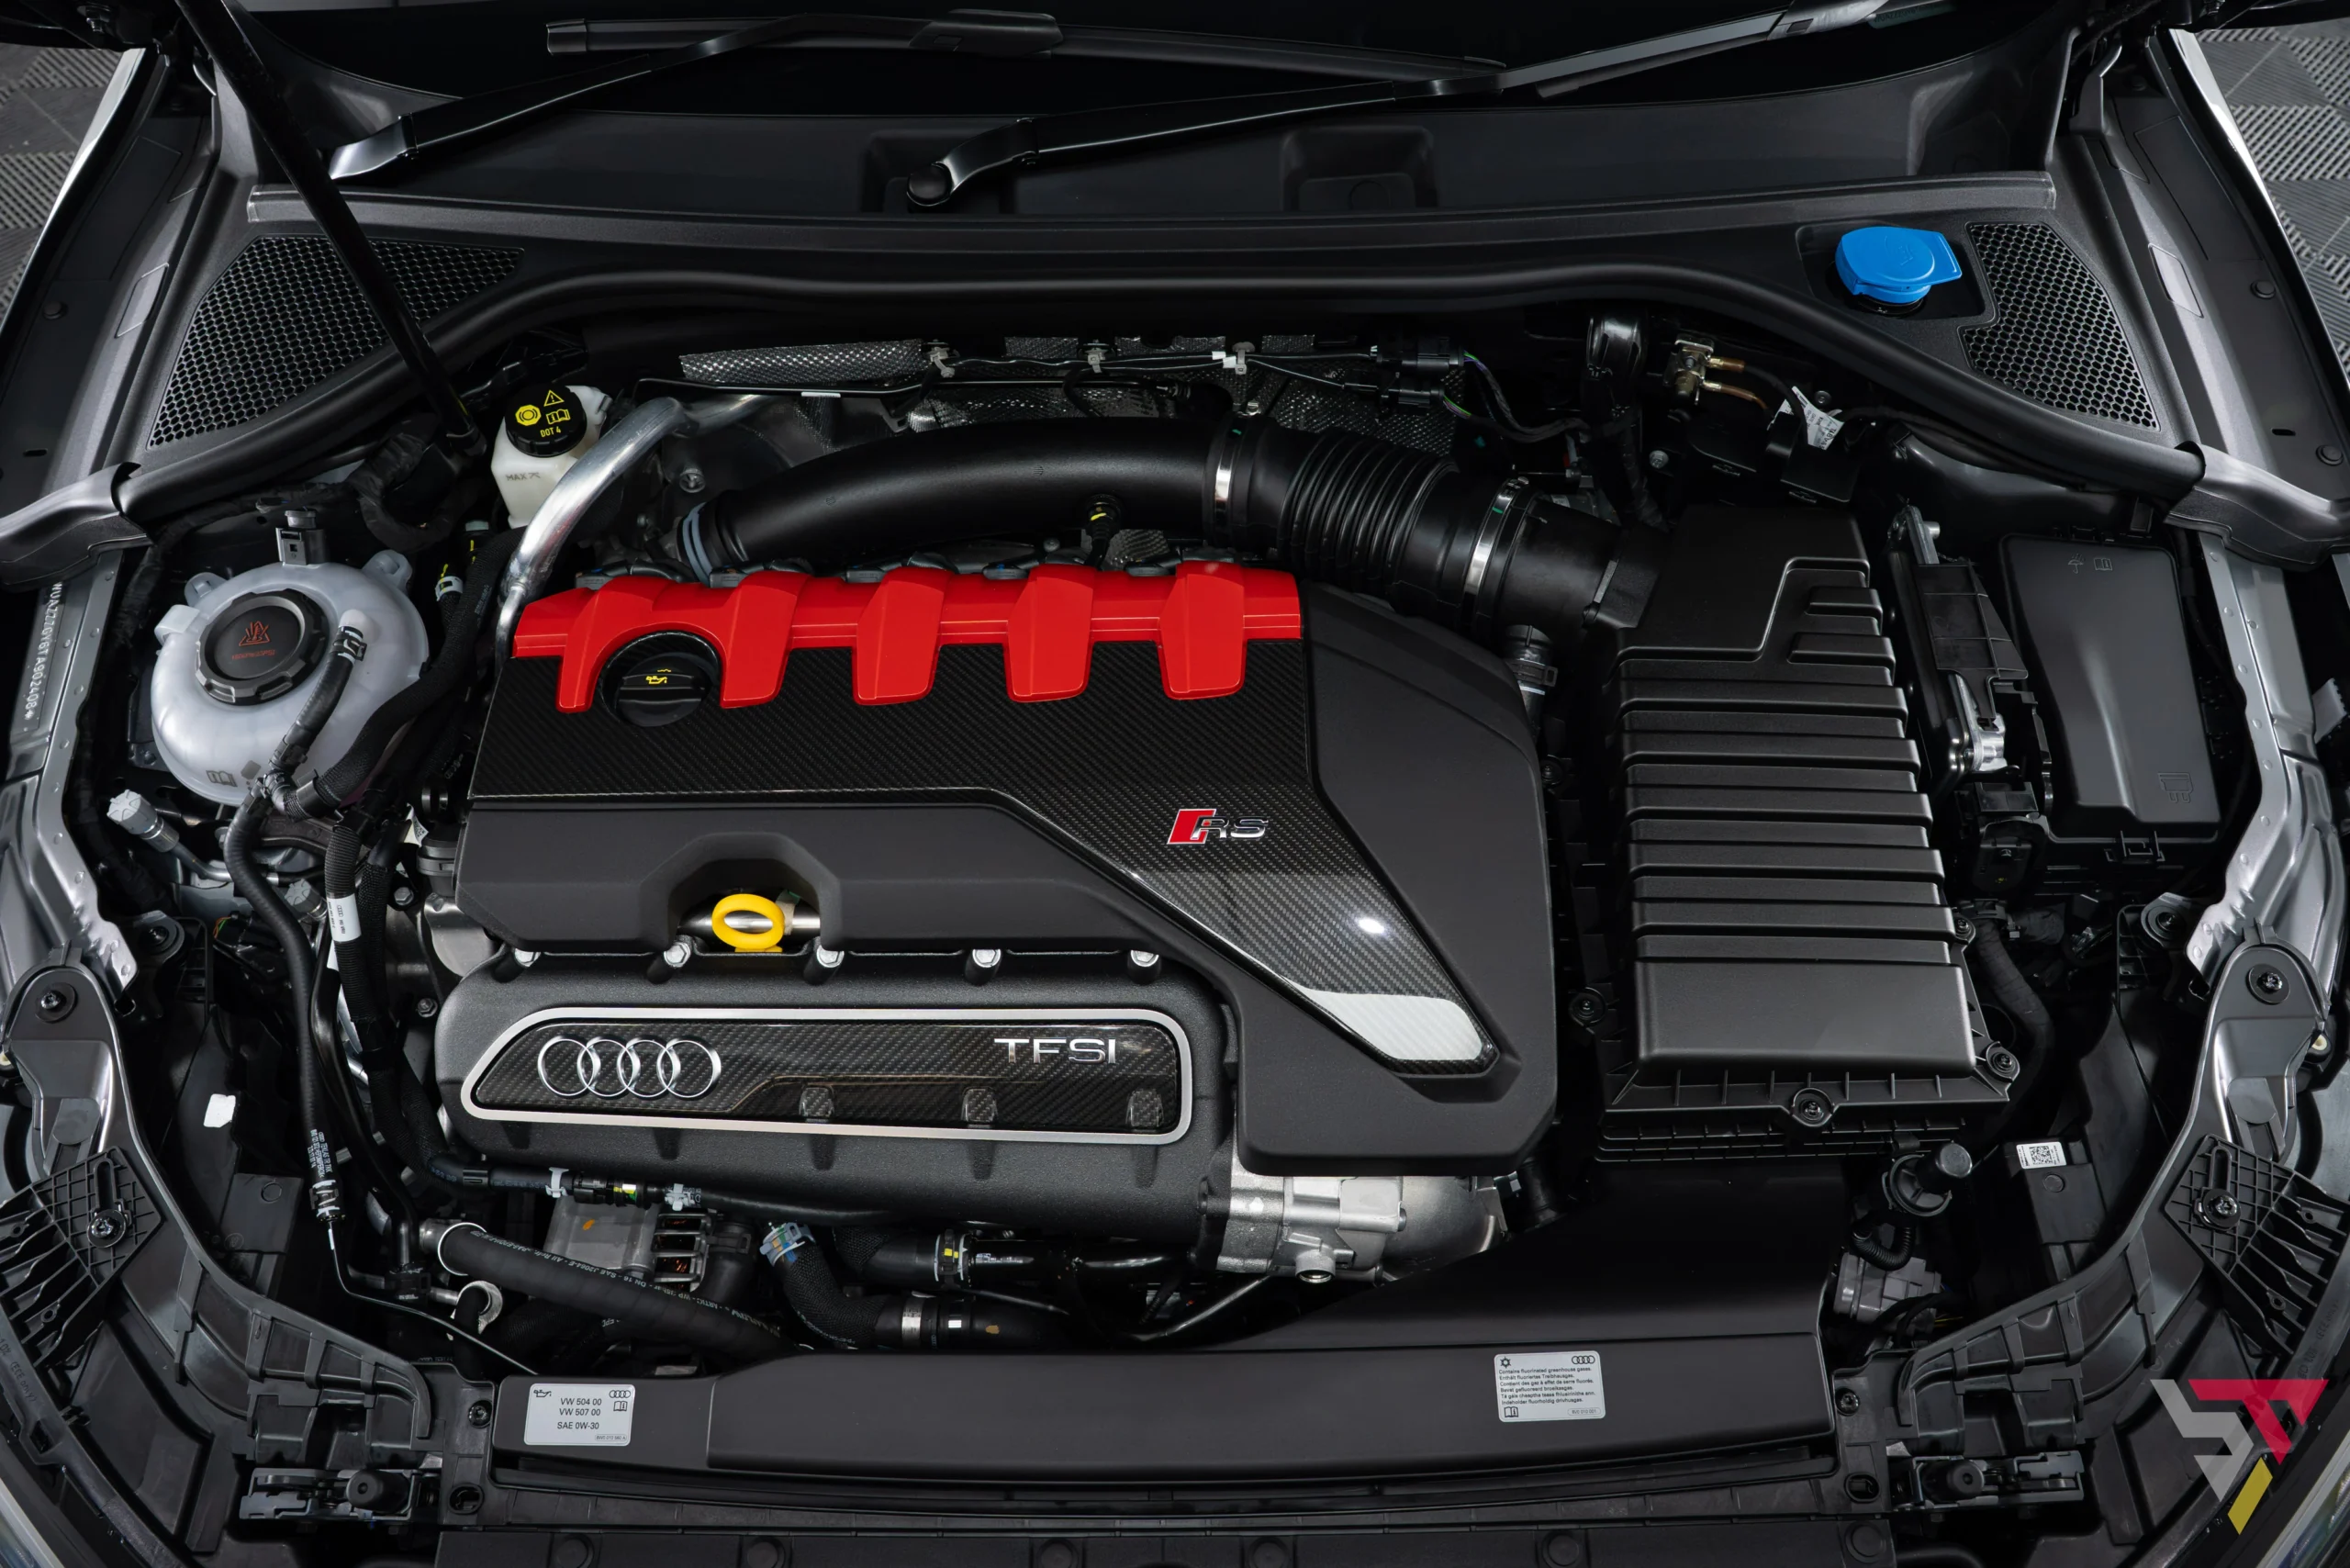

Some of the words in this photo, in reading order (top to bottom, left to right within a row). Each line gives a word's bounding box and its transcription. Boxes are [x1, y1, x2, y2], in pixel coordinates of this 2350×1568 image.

[540, 428, 554, 438] DOT
[506, 473, 527, 481] MAX
[1167, 808, 1269, 845] RS
[994, 1037, 1116, 1064] TFSI
[600, 1269, 615, 1278] SAE
